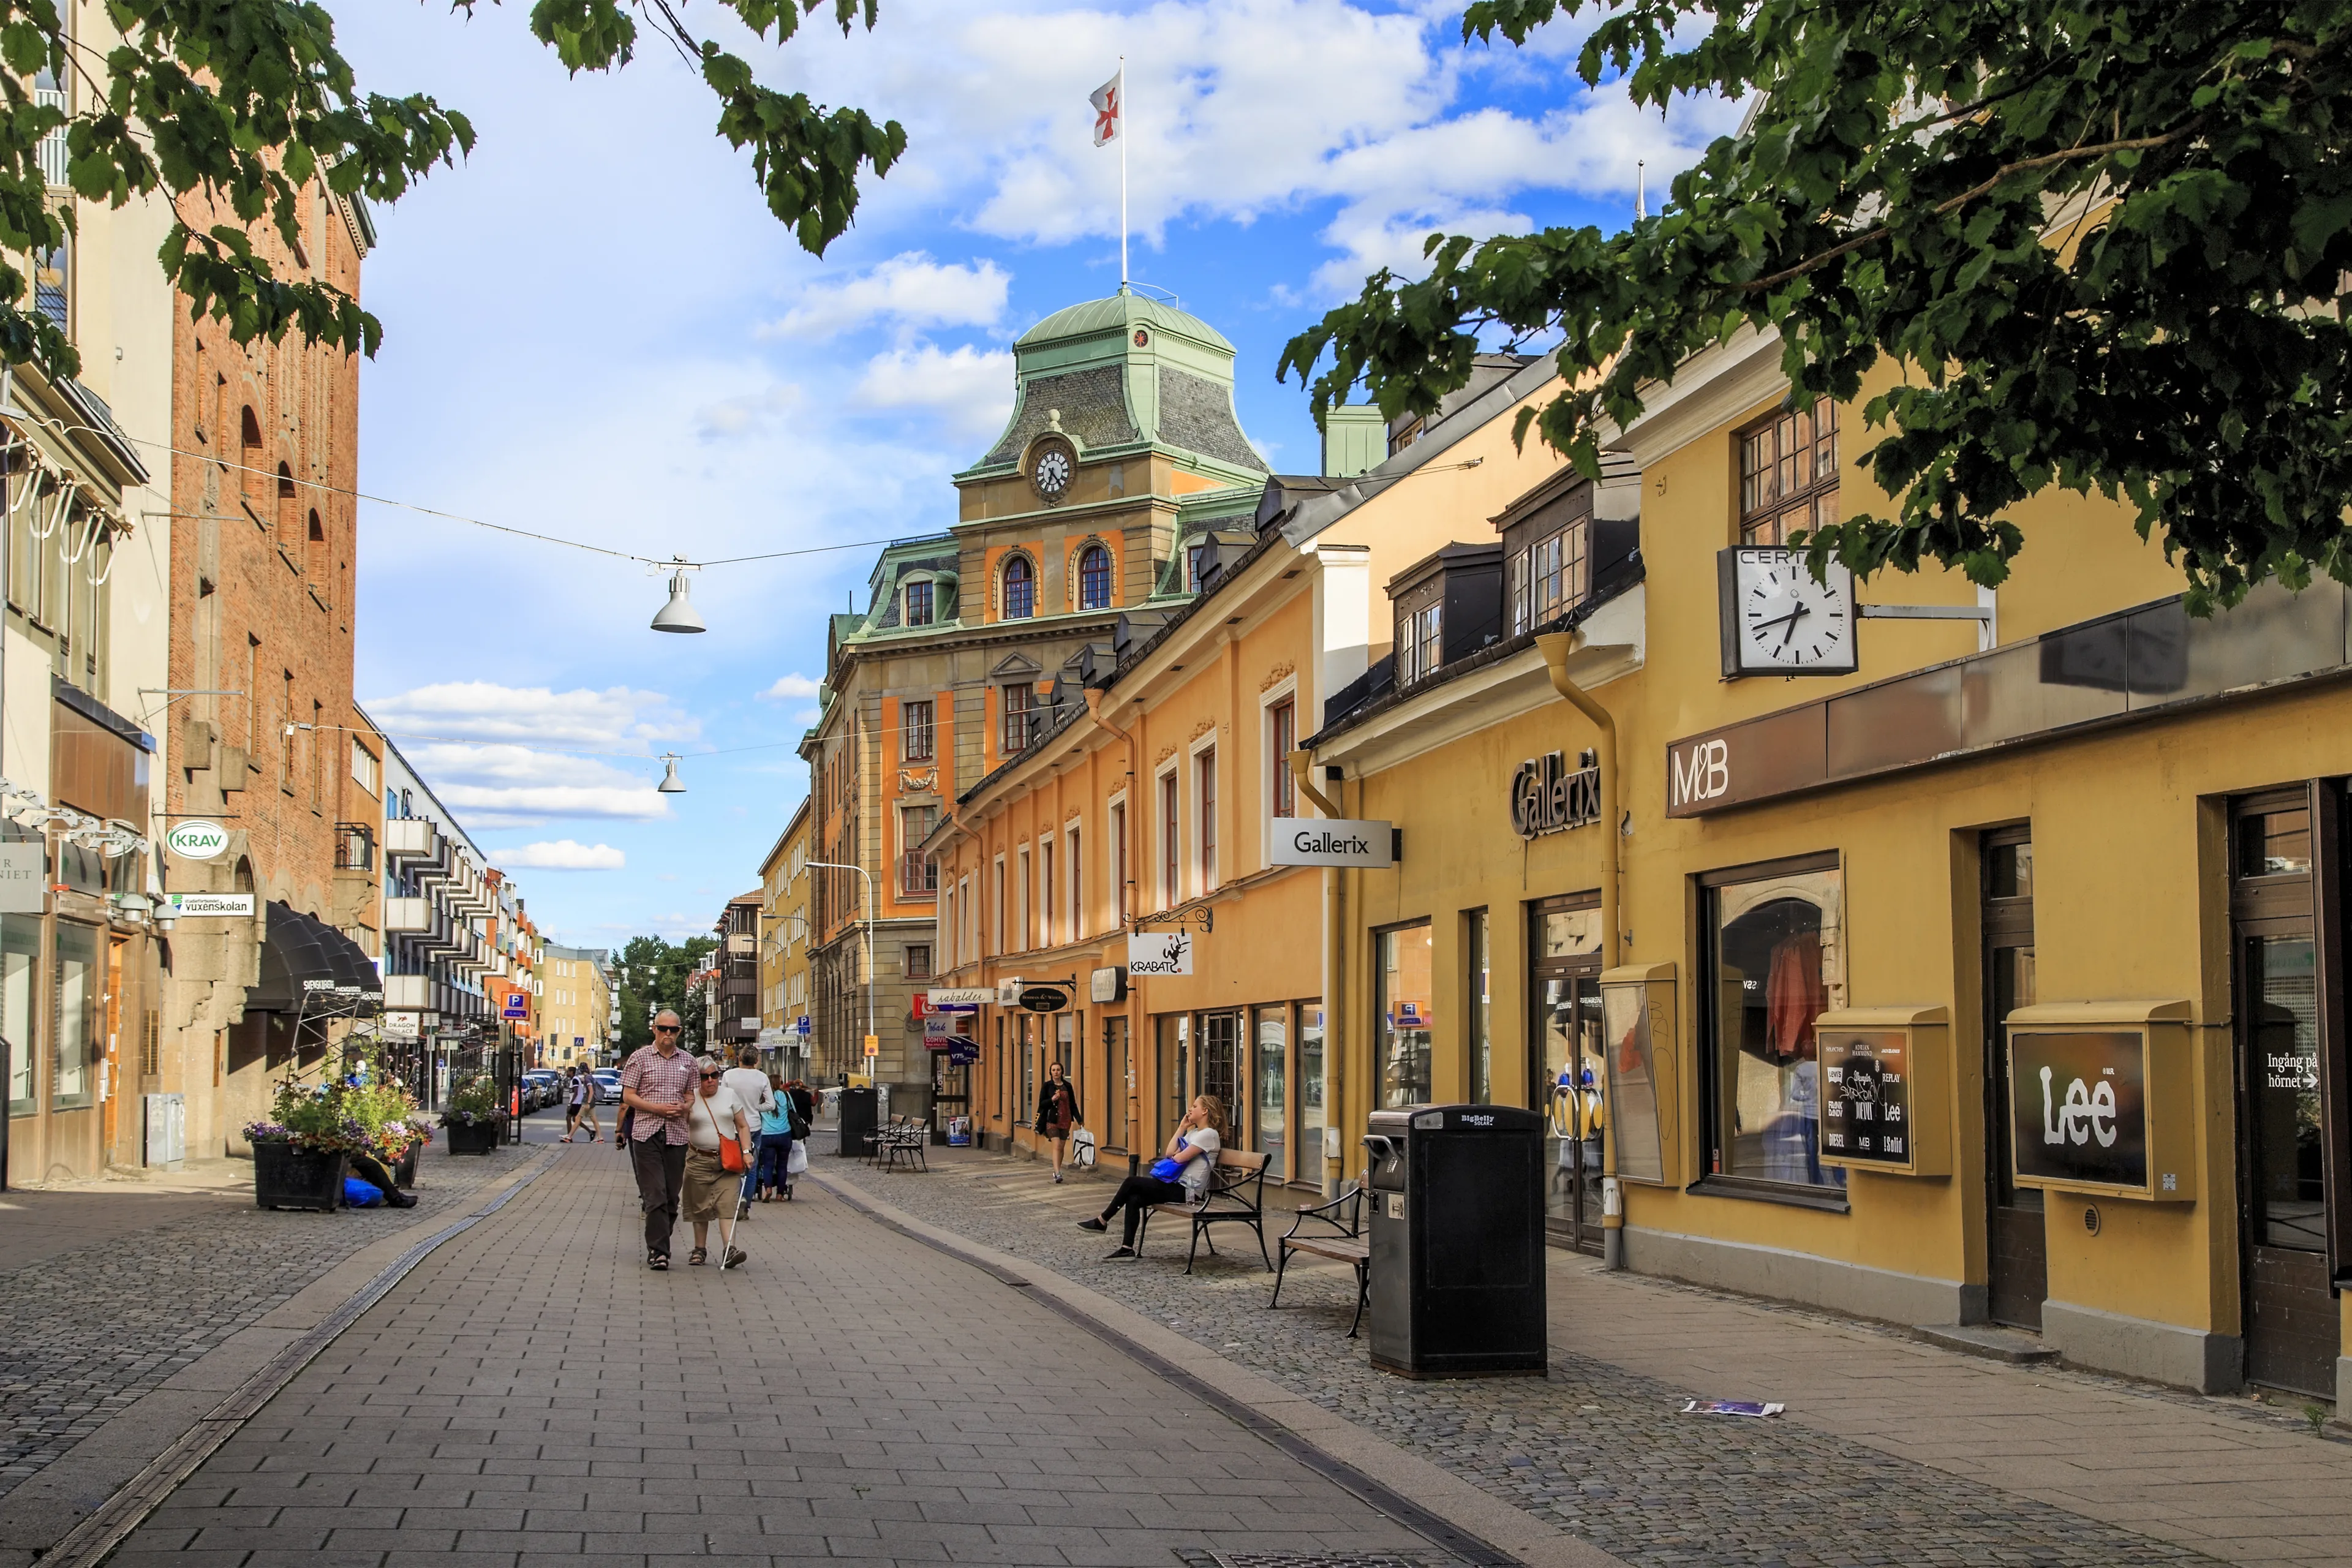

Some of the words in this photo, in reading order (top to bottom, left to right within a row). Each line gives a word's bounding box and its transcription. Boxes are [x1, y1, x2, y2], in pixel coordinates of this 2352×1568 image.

[1740, 551, 1840, 564] CERTA
[1509, 748, 1601, 839] Gallerix
[176, 834, 222, 847] KRAV
[1294, 831, 1370, 854] Gallerix
[186, 902, 247, 911] vuxenskolan
[1131, 961, 1172, 973] KRABAT
[512, 995, 520, 1006] P
[937, 991, 986, 1003] rabalder
[801, 1017, 807, 1026] P
[2267, 1052, 2304, 1073] Ingång
[2305, 1052, 2318, 1072] på
[1882, 1073, 1901, 1083] REPLAY
[2267, 1072, 2302, 1088] hörnet
[1884, 1101, 1901, 1121] Lee
[2039, 1065, 2117, 1148] Lee
[1829, 1133, 1845, 1148] DIESEL
